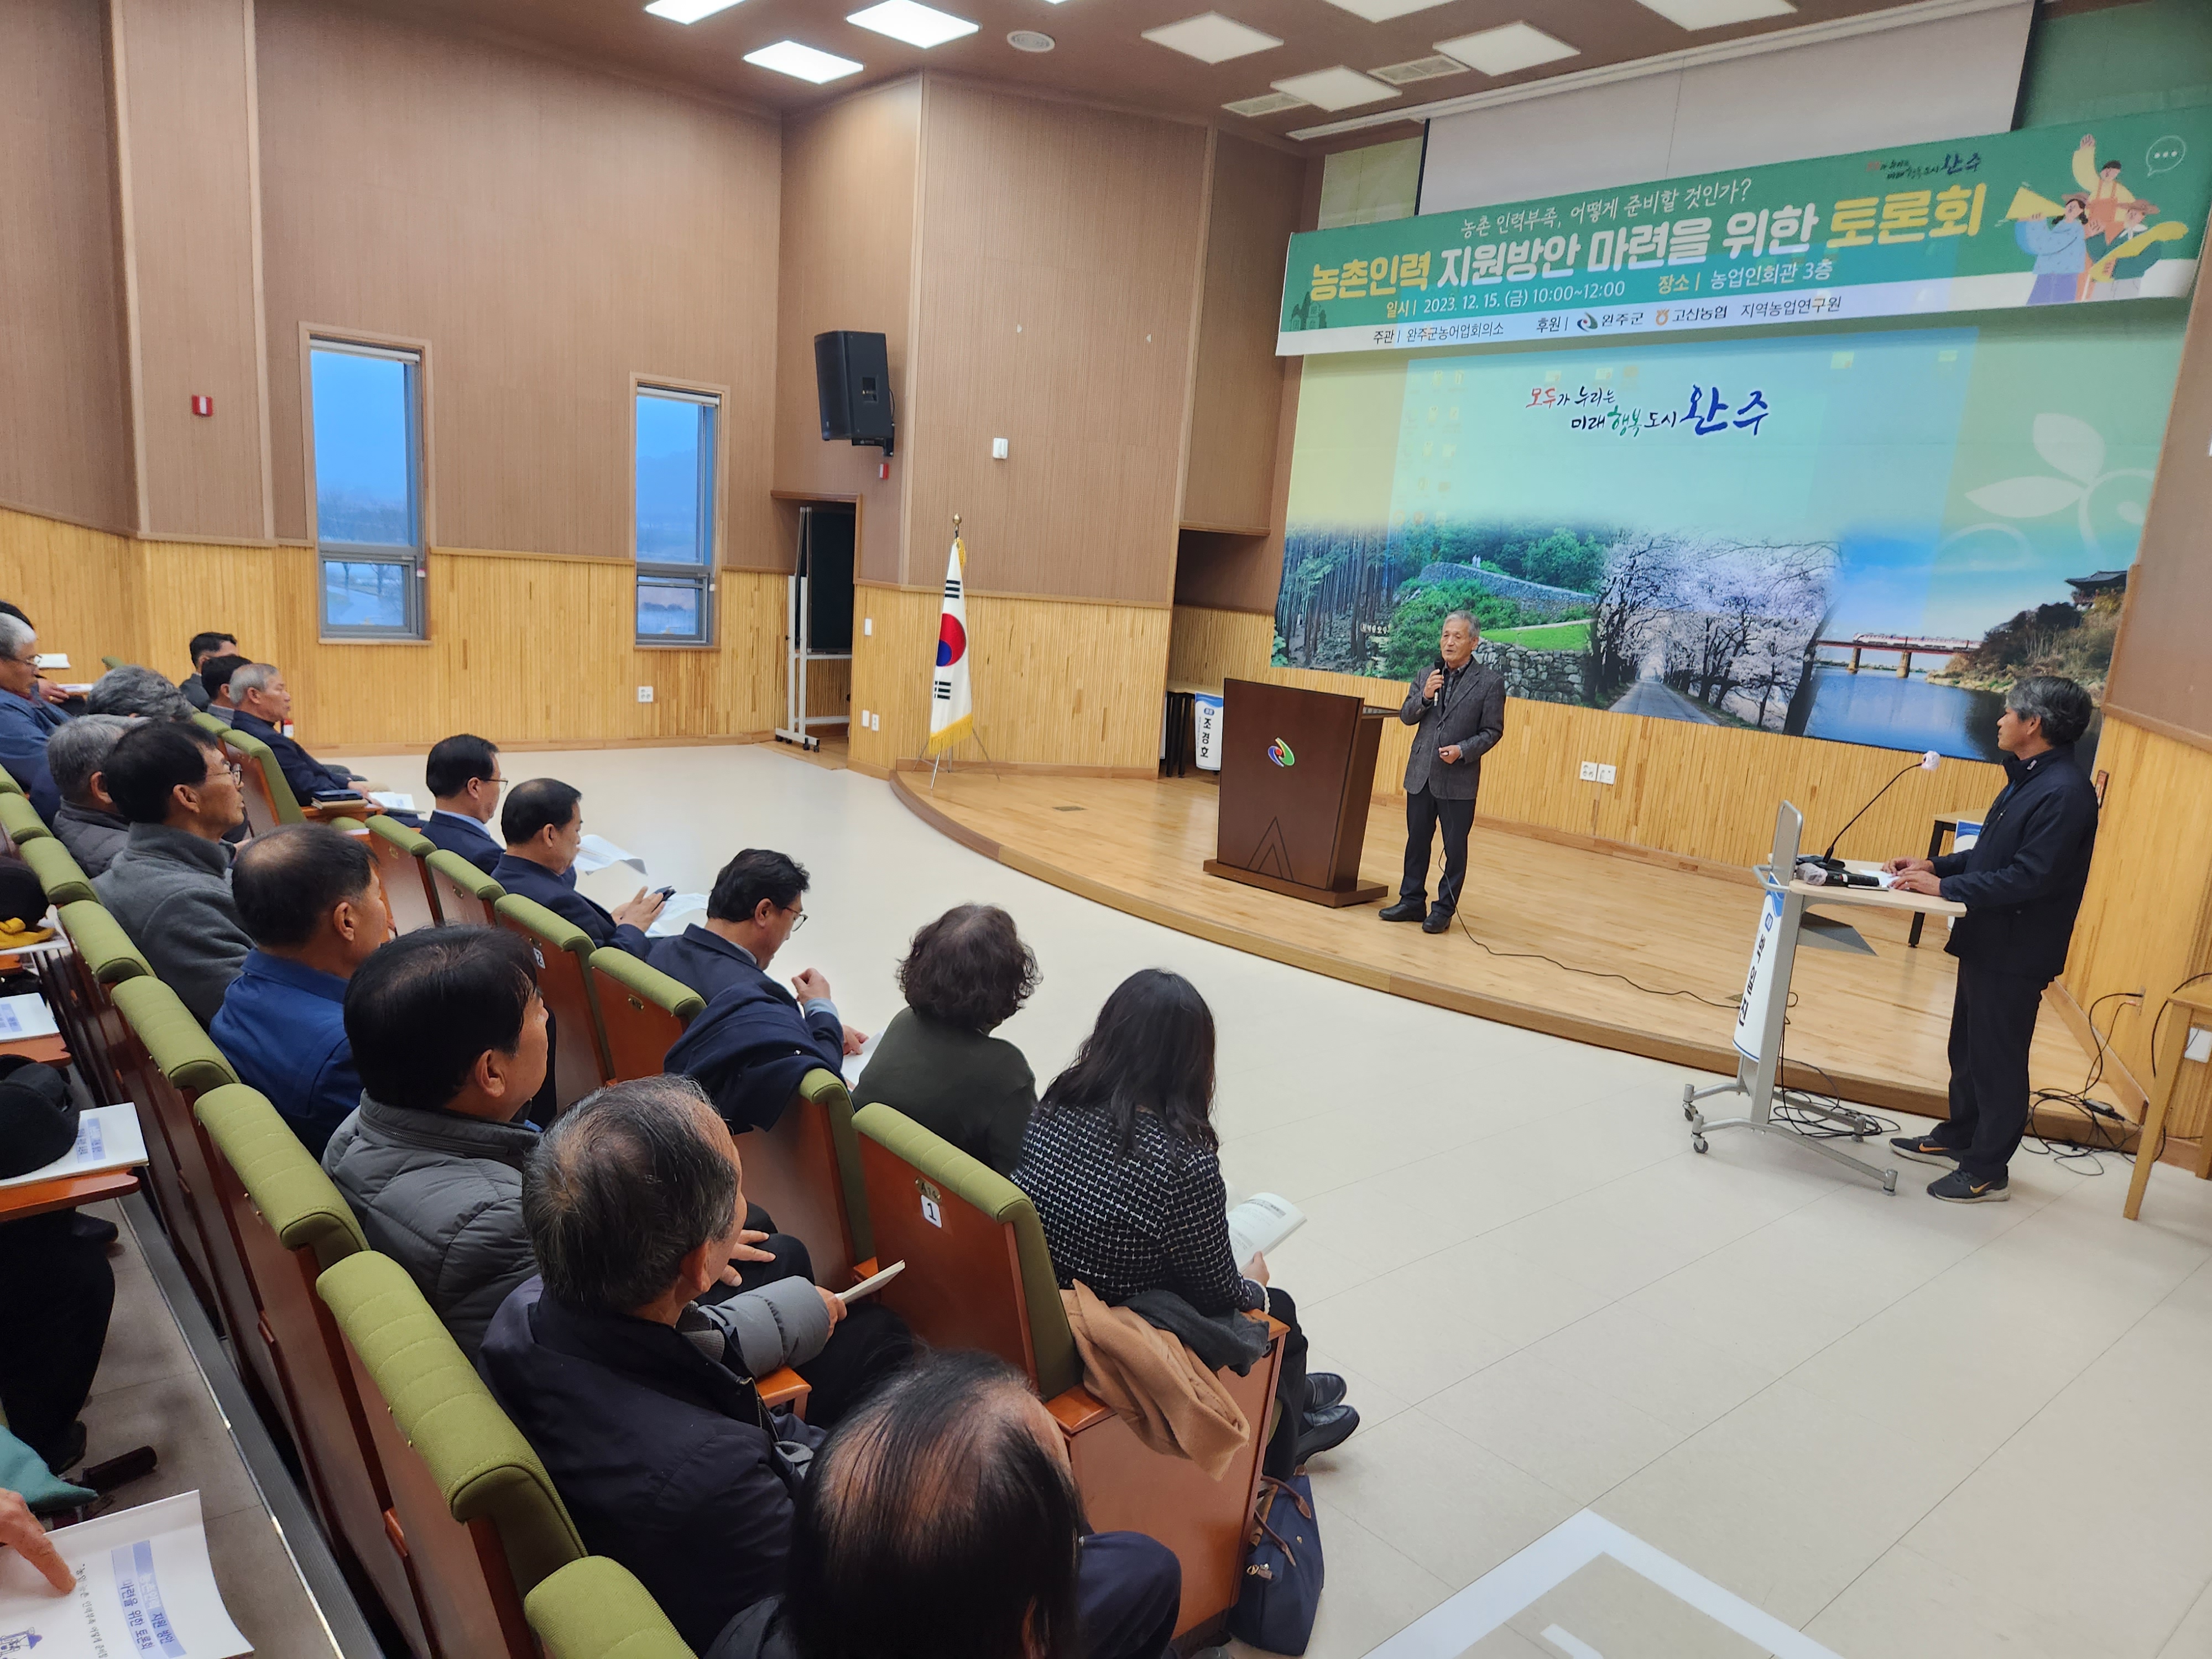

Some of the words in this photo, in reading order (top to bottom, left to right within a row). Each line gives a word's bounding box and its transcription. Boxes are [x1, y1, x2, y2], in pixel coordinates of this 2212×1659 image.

[1461, 215, 1491, 238] 농촌
[1497, 207, 1561, 234] 인력부족,
[1571, 197, 1618, 224] 어떻게
[1624, 189, 1679, 217] 준비할
[1684, 178, 1752, 210] 것인가?
[1311, 251, 1431, 301] 농촌인력
[1437, 233, 1581, 288] 지원방안
[1587, 217, 1712, 272] 마련을
[1723, 202, 1819, 259] 위한
[1827, 182, 1987, 248] 토론회
[1386, 299, 1410, 319] 일시
[1423, 297, 1457, 314] 2023.
[1463, 294, 1479, 310] 12.
[1484, 293, 1500, 308] 15.
[1505, 289, 1528, 307] (금)
[1533, 280, 1625, 304] 10:00~12:00
[1658, 274, 1689, 295] 장소
[1710, 262, 1798, 290] 농업인회관
[1803, 259, 1833, 281] 3층
[1373, 330, 1395, 345] 주관
[1407, 321, 1504, 343] 완주군농어업회의소
[1536, 316, 1561, 333] 후원
[1741, 296, 1842, 319] 지역농업연구원
[1526, 387, 1571, 409] 모두가
[1574, 385, 1616, 408] 누리는
[927, 1202, 937, 1222] 1
[121, 1578, 138, 1608] 마련을
[128, 1610, 145, 1626] 위한
[152, 1612, 168, 1629] 지원
[135, 1629, 155, 1650] 토론회
[156, 1629, 175, 1645] 방안
